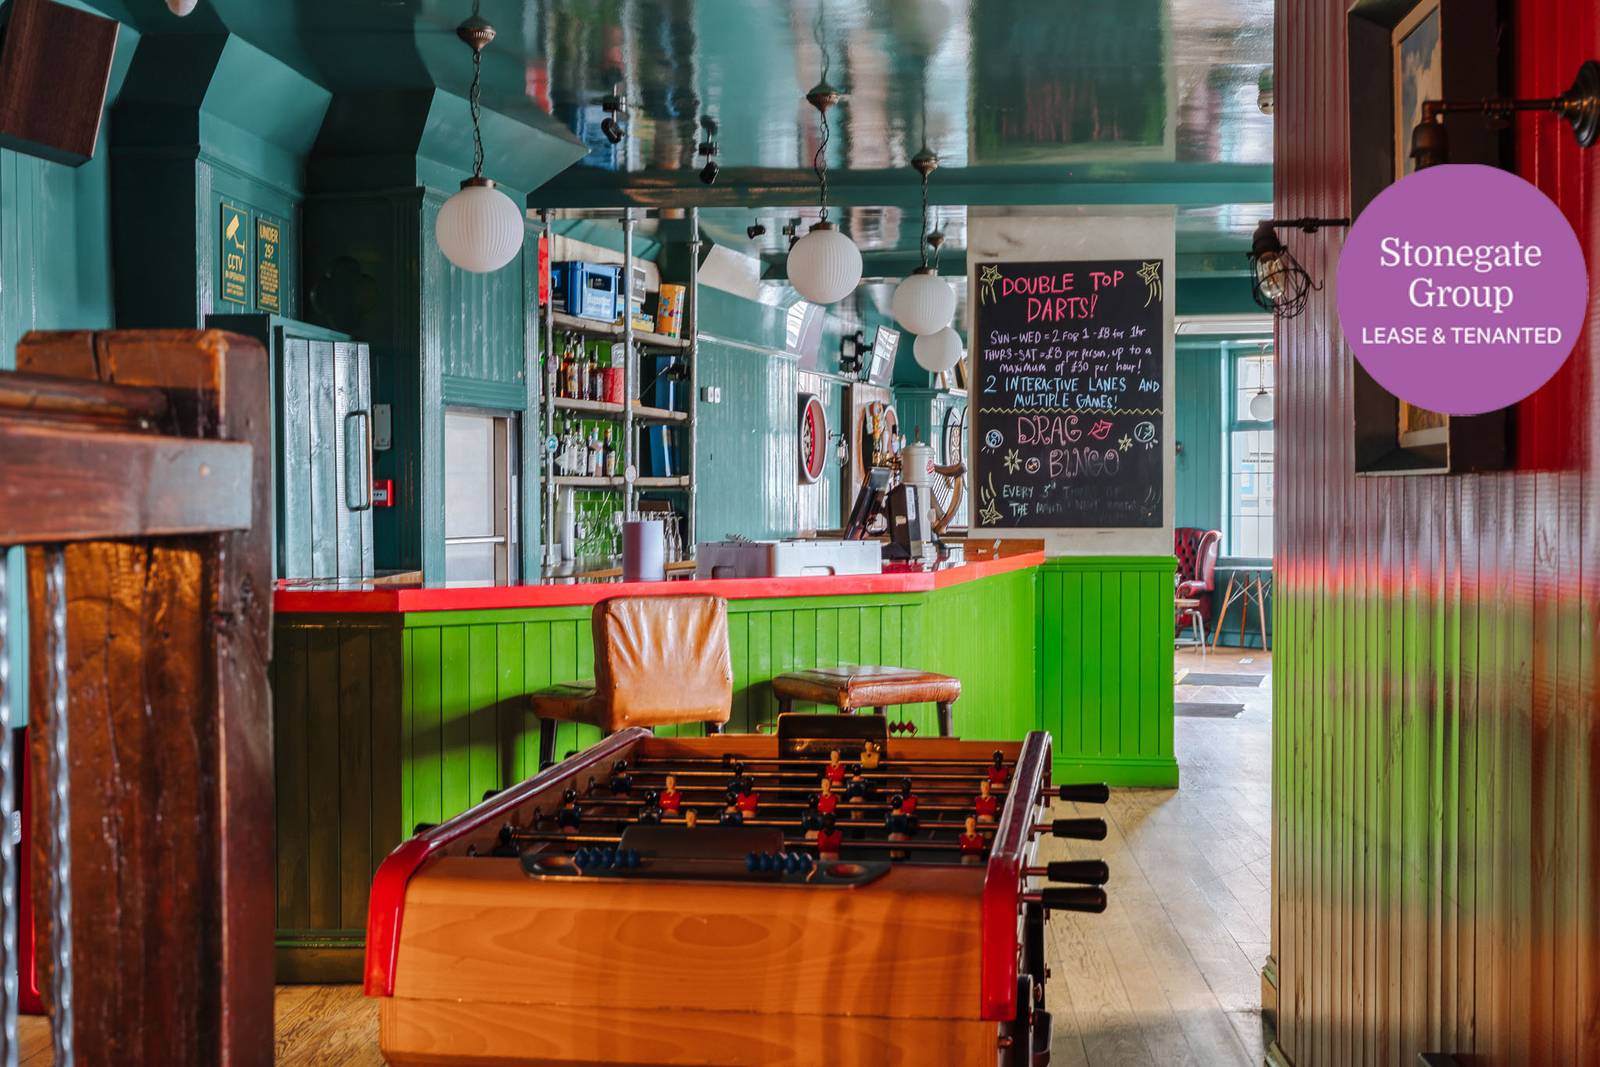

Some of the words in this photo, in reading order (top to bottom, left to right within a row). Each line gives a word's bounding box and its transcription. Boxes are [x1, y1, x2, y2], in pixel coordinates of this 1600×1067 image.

[1002, 272, 1074, 297] DOUBLE
[1027, 294, 1098, 323] DARTS!
[1129, 344, 1142, 355] to
[1145, 347, 1153, 355] a
[1055, 360, 1065, 376] of
[1095, 364, 1109, 379] per
[983, 375, 997, 393] 2
[1005, 375, 1080, 393] INTERACTIVE
[1088, 376, 1127, 392] LANES
[1138, 377, 1160, 392] AND
[1014, 392, 1069, 408] MULTIPLE
[1076, 394, 1118, 410] GAMES!
[1017, 415, 1082, 446] DRAG
[1049, 447, 1120, 478] BINGO
[1002, 485, 1034, 499] EVERY
[1009, 502, 1029, 517] THE
